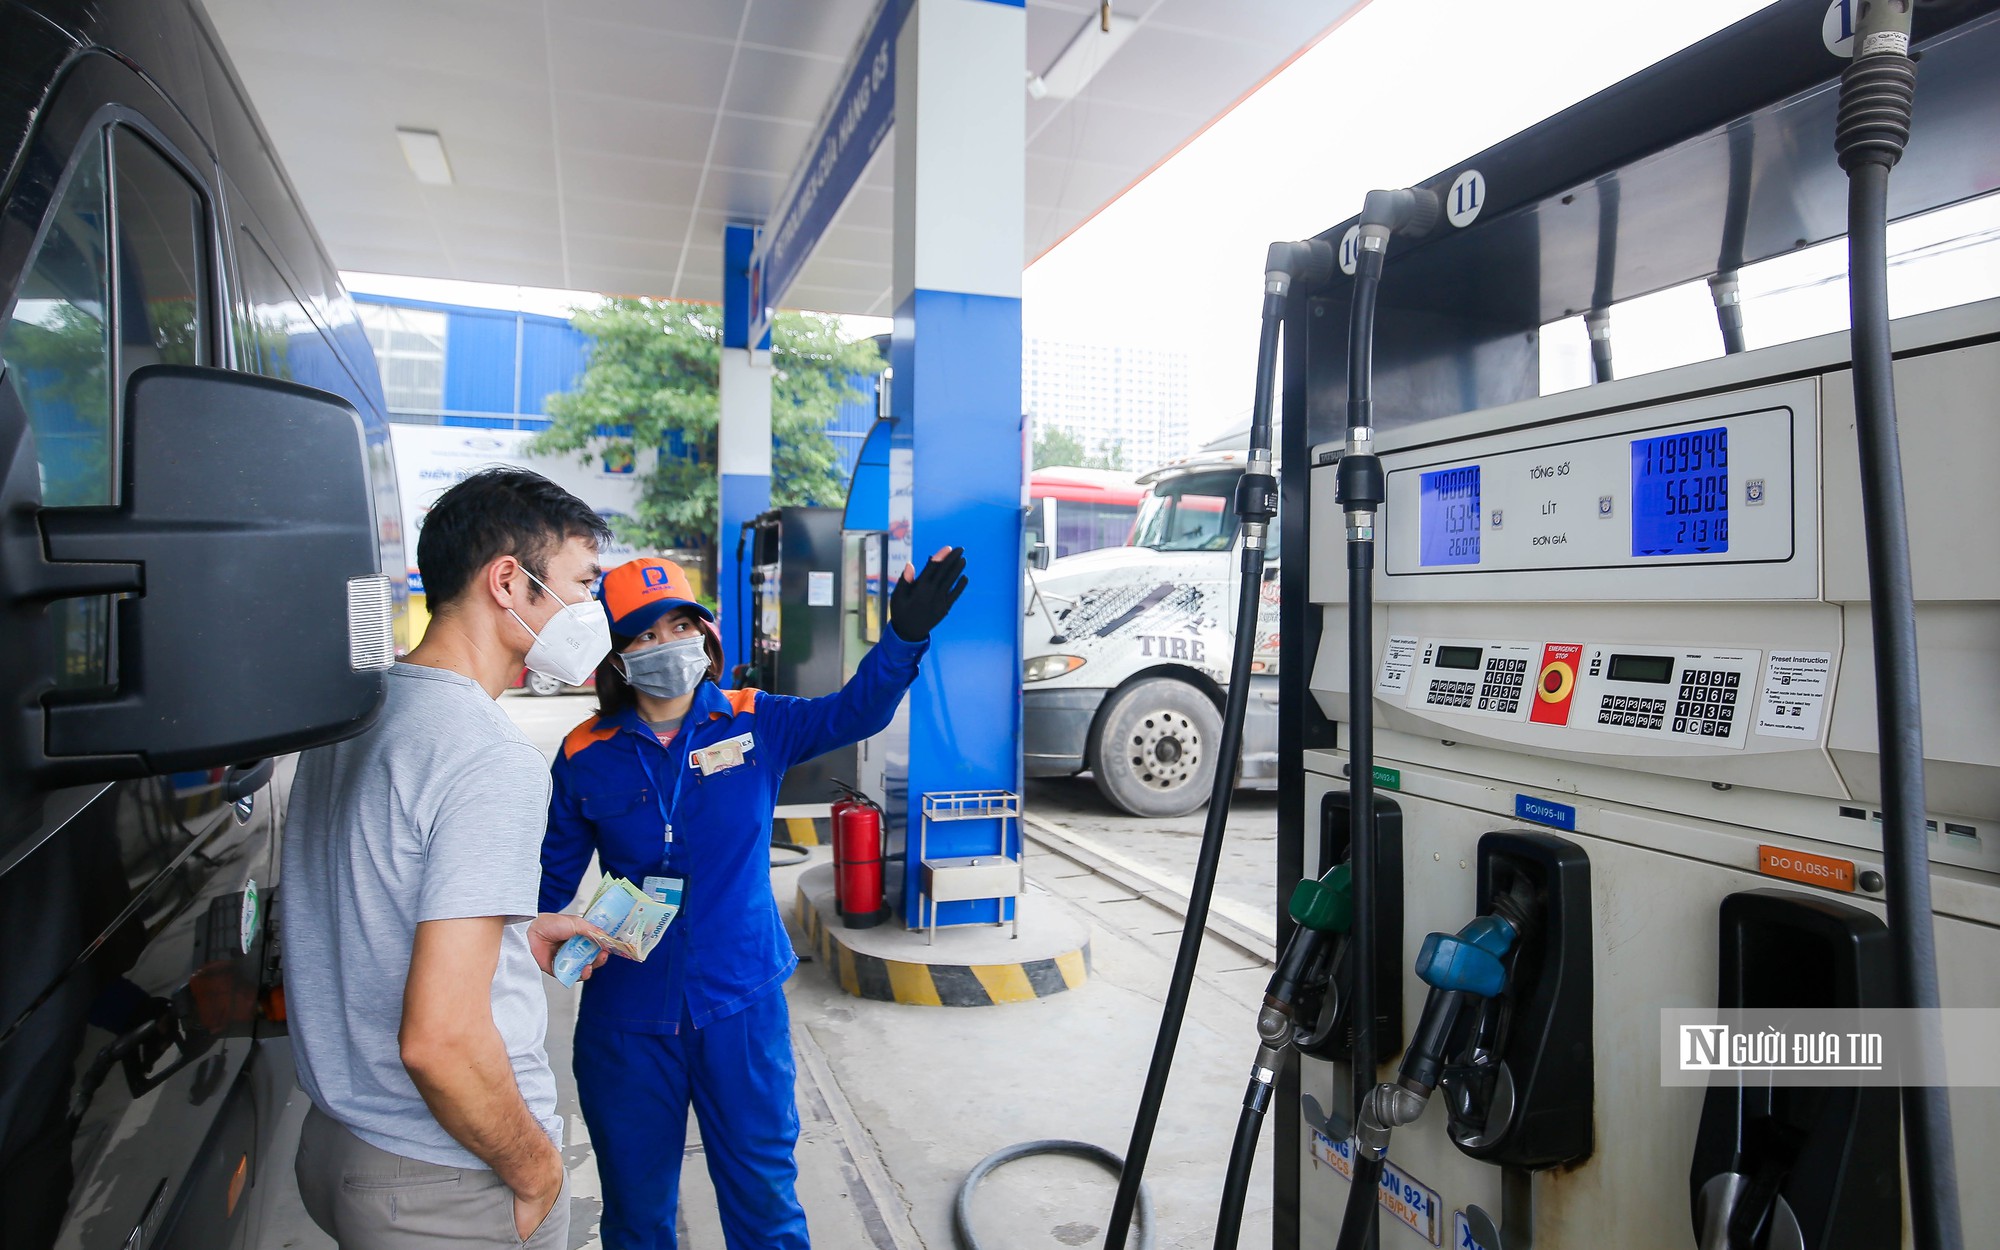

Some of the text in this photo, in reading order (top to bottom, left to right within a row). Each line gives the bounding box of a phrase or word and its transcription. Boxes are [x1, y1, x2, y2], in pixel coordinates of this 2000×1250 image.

[1834, 0, 1854, 44] 1
[1454, 176, 1478, 216] 11
[1557, 461, 1570, 476] SỐ
[1542, 500, 1557, 515] LÍT
[1532, 533, 1567, 546] ĐƠN GIÁ
[1137, 636, 1205, 663] TIRE
[1490, 660, 1495, 668] 7
[1499, 661, 1504, 669] 8
[1509, 661, 1514, 670] 9
[1486, 673, 1492, 682] 4
[1496, 674, 1502, 683] 5
[1506, 675, 1511, 683] 6
[1686, 672, 1693, 682] 7
[1700, 673, 1706, 683] 8
[1714, 674, 1721, 684] 9
[1484, 686, 1488, 695] 1
[1493, 687, 1499, 696] 2
[1503, 688, 1508, 697] 3
[1682, 688, 1689, 698] 4
[1696, 689, 1704, 700] 5
[1711, 690, 1718, 701] 6
[1481, 699, 1485, 708] 0
[1490, 700, 1496, 709] C
[1615, 699, 1625, 707] P2
[1628, 700, 1638, 708] P3
[1641, 702, 1651, 710] P4
[1654, 703, 1665, 711] P5
[1680, 704, 1685, 714] 1
[1693, 706, 1700, 716] 2
[1708, 707, 1715, 717] 3
[1624, 716, 1635, 724] P8
[1637, 717, 1648, 726] P9
[1650, 718, 1662, 727] P10
[1676, 720, 1683, 730] 0
[1690, 721, 1698, 732] C
[1526, 803, 1565, 821] RON95-III
[1771, 856, 1790, 868] DO
[1325, 1148, 1348, 1175] TCCS
[1380, 1168, 1400, 1196] ON
